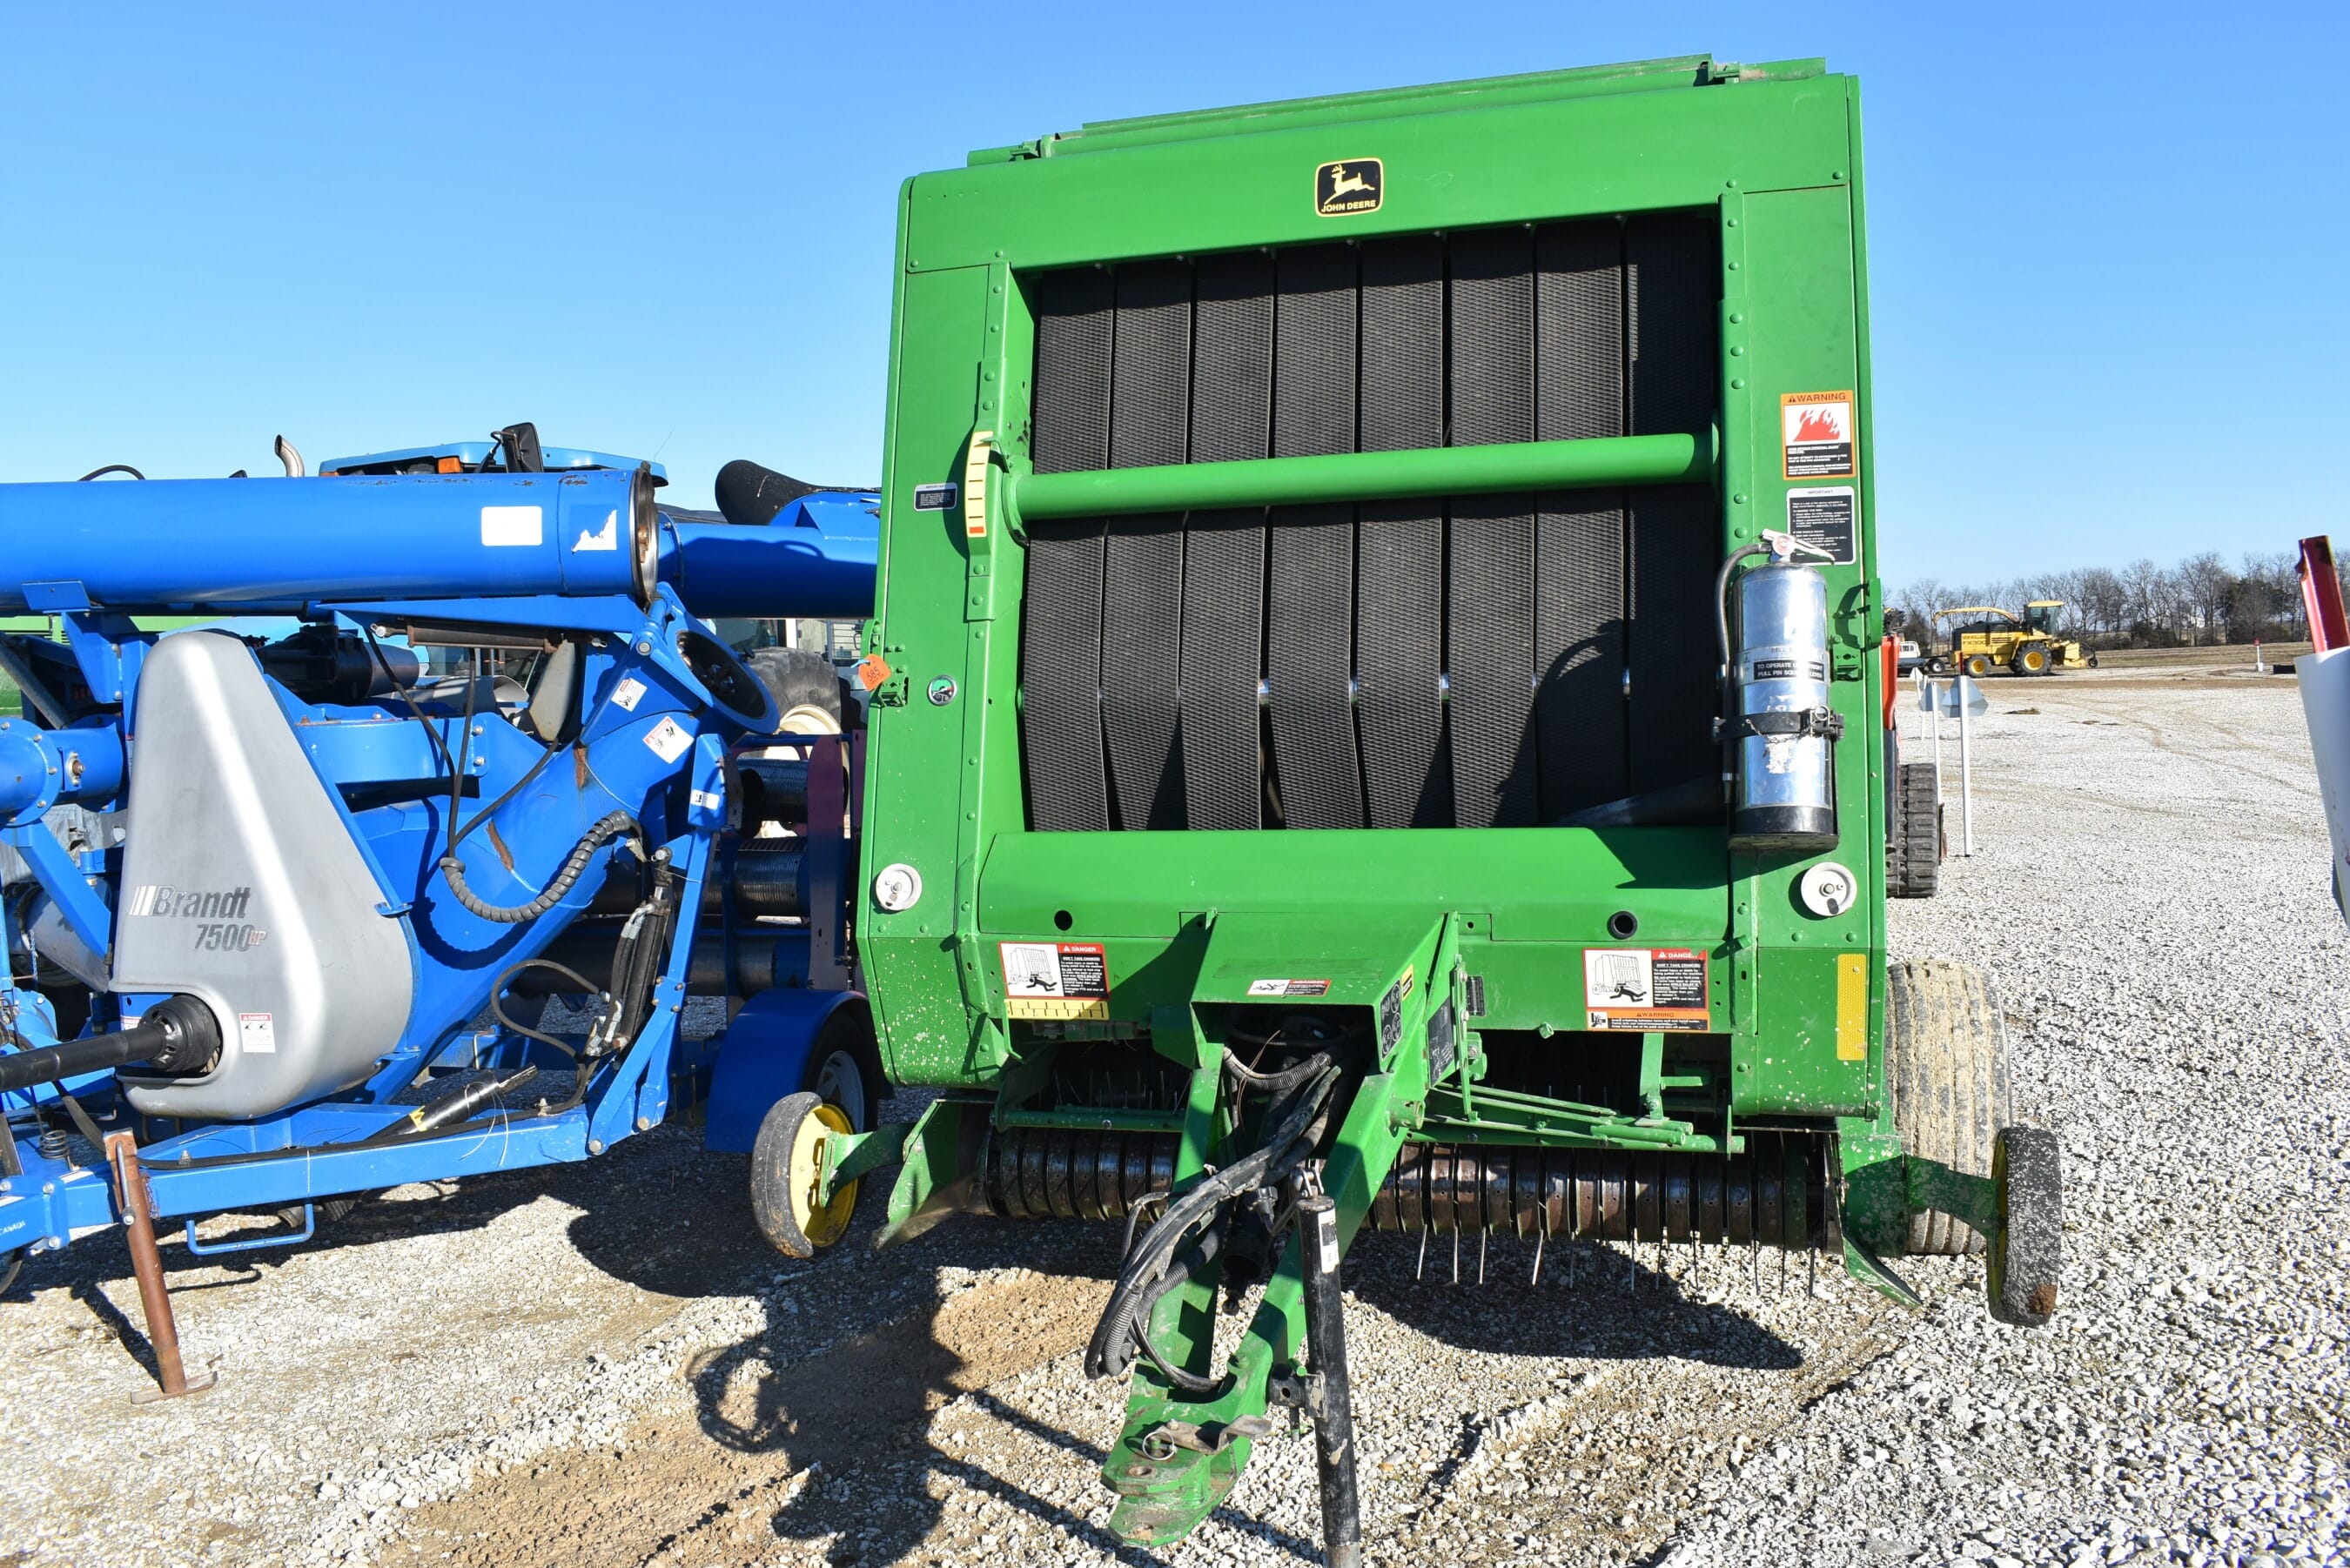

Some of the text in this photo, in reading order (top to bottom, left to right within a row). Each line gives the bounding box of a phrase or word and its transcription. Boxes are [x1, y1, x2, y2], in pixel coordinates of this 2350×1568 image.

[1321, 199, 1376, 212] JOHN DEERE
[1796, 392, 1846, 402] WARNING
[866, 666, 881, 681] 585
[151, 886, 252, 919] Brandt
